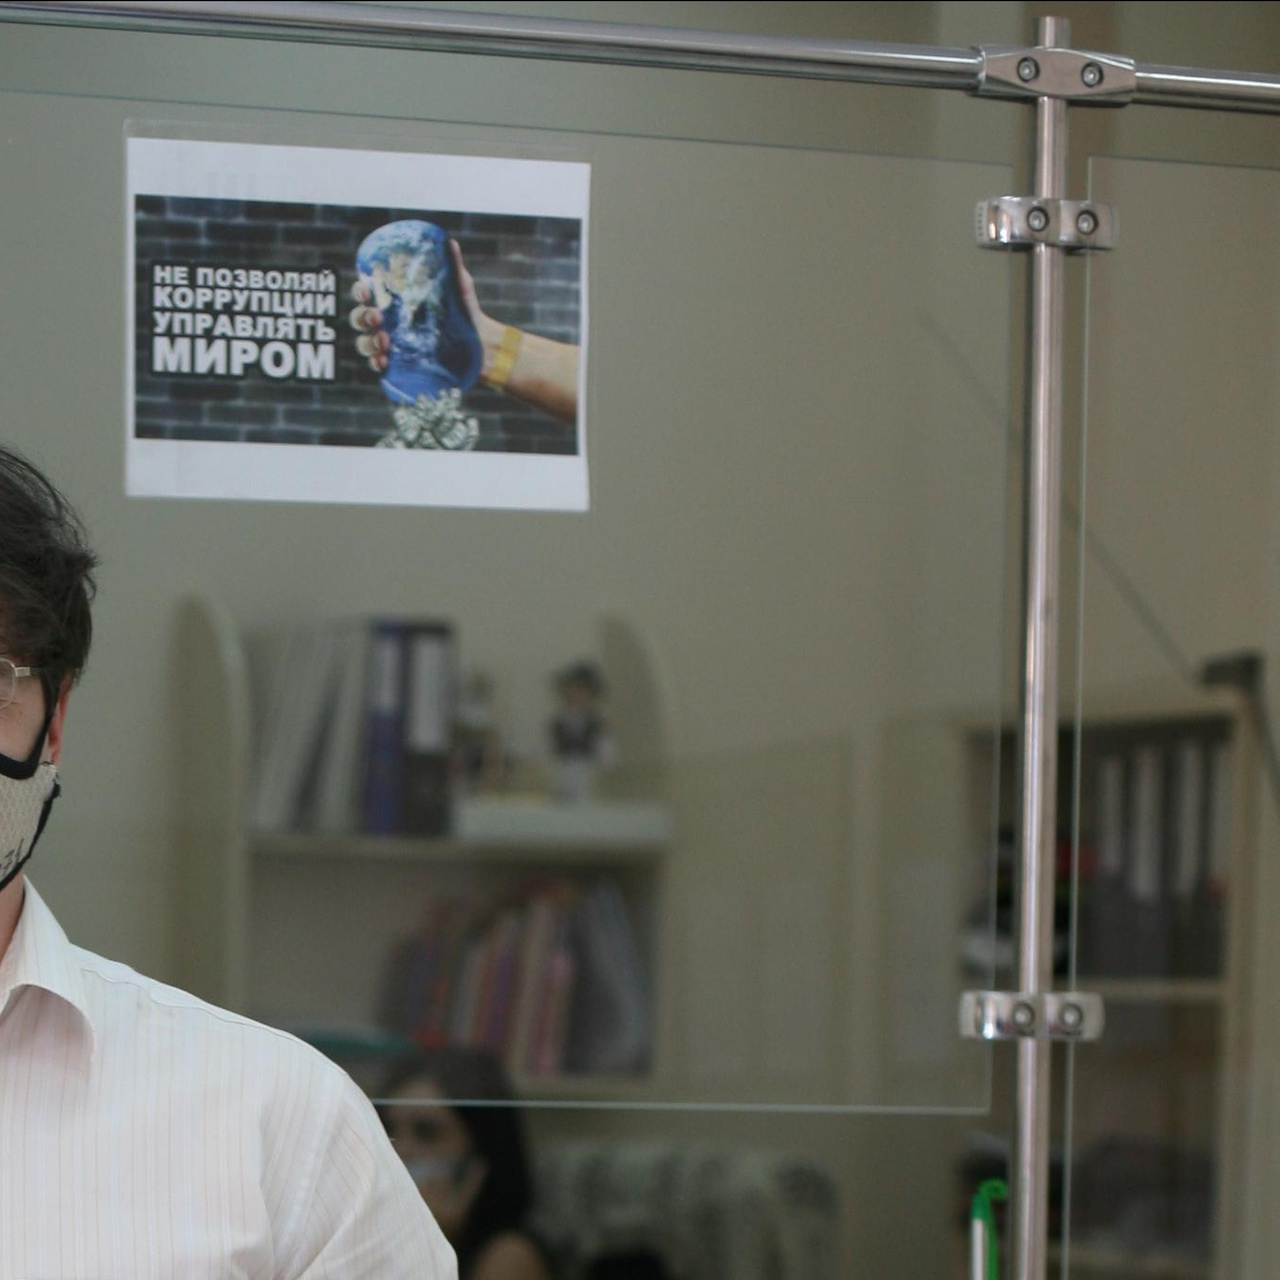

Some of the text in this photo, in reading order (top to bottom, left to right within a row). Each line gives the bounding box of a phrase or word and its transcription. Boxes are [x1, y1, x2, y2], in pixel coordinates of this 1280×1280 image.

[154, 264, 337, 293] НЕ ПОЗВОЛЯЙ
[153, 286, 337, 317] КОРРУПЦИИ
[153, 311, 337, 342] УПРАВЛЯТЬ
[152, 336, 337, 381] МИРОМ
